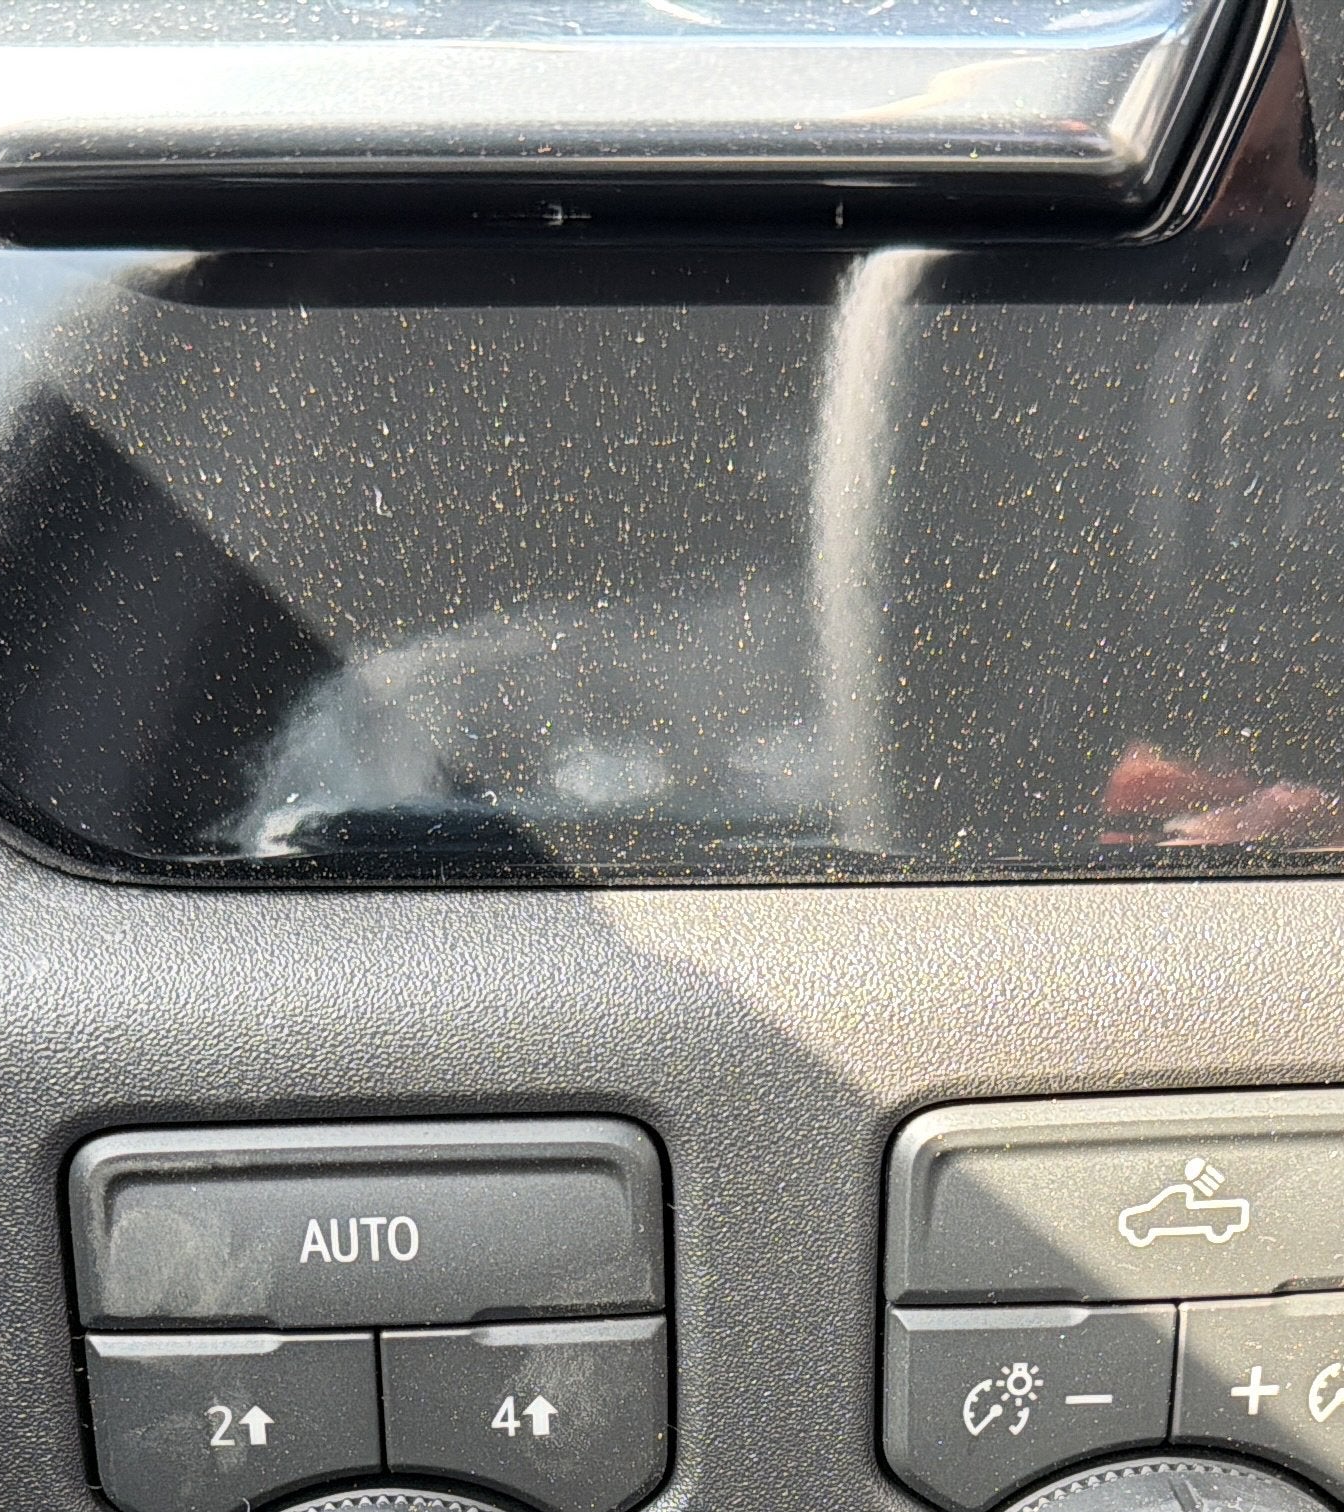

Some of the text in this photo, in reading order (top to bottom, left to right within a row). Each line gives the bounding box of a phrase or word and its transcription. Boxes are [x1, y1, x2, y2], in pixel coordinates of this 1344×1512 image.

[299, 1215, 419, 1263] AUTO
[207, 1405, 236, 1446] 2
[490, 1395, 521, 1437] 4
